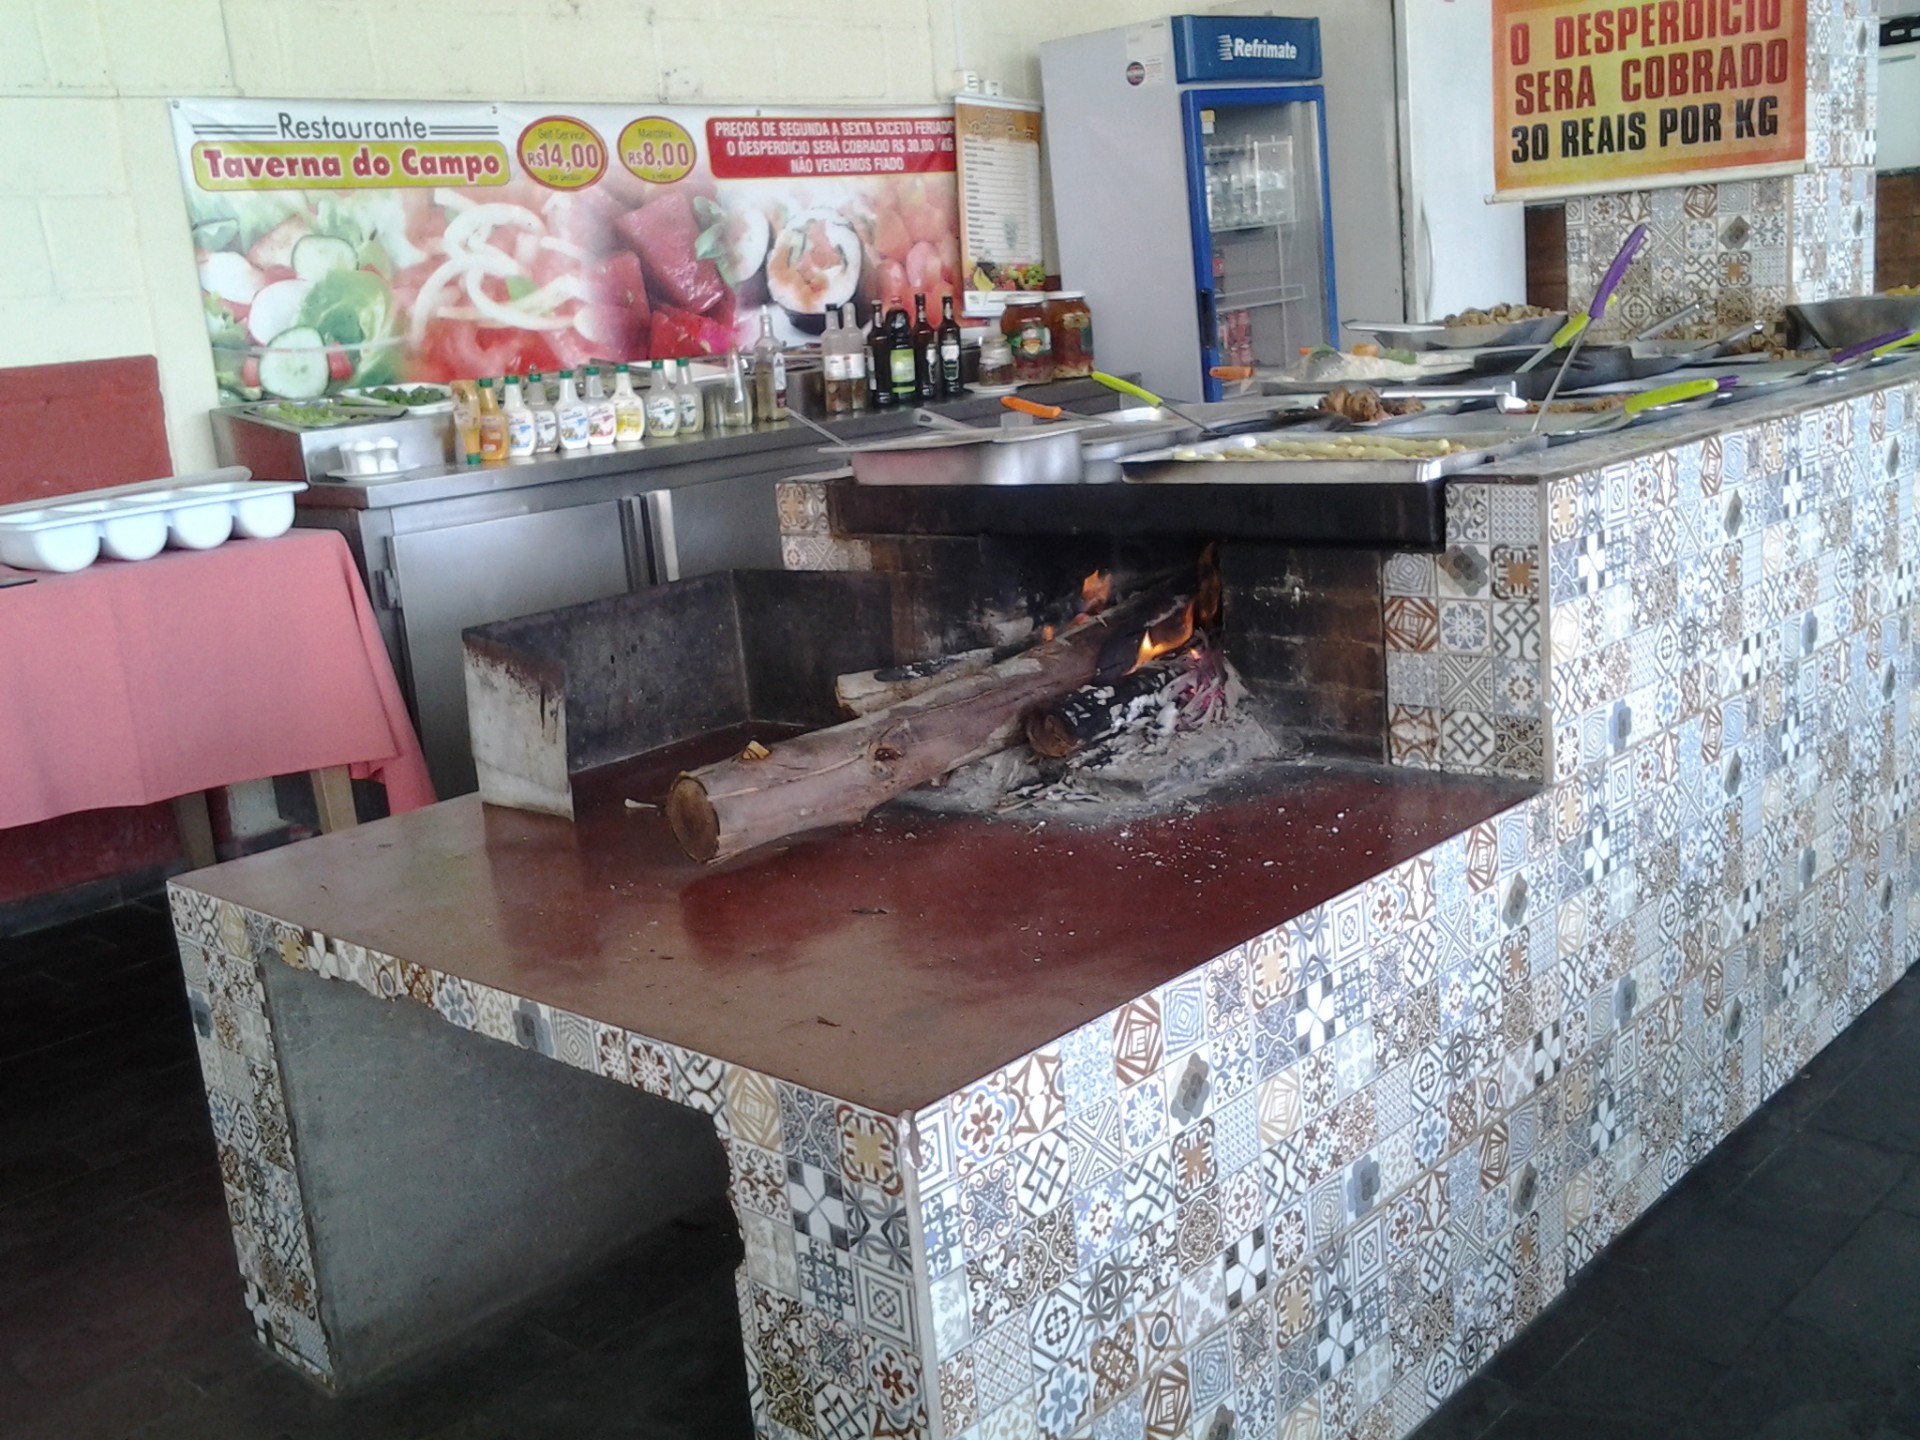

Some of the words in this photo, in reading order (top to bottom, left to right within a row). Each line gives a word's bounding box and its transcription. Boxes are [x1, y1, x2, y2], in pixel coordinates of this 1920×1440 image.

[1510, 22, 1530, 66] O
[1555, 0, 1781, 60] DESPERDICIO
[1234, 38, 1297, 60] Refrimate
[1515, 65, 1596, 116] SERA
[1621, 38, 1788, 102] COBRADO
[278, 112, 427, 139] Restaurante
[714, 121, 760, 140] PREÇOS
[762, 122, 777, 136] DE
[779, 121, 830, 137] SEGUNDA
[832, 121, 841, 136] A
[842, 121, 873, 136] SEXTA
[876, 121, 913, 135] EXCETO
[1511, 123, 1549, 163] 30
[1561, 111, 1646, 158] REAIS
[1659, 102, 1722, 147] POR
[1735, 95, 1778, 139] KG
[727, 141, 736, 156] O
[738, 138, 810, 156] DESPERDÍCIO
[812, 137, 841, 154] SERÁ
[841, 139, 890, 154] COBRADO
[203, 148, 341, 179] Taverna
[352, 147, 391, 177] do
[401, 148, 500, 182] Campo
[790, 156, 813, 173] NÃO
[815, 157, 872, 172] VENDEMOS
[874, 157, 905, 171] FIADO
